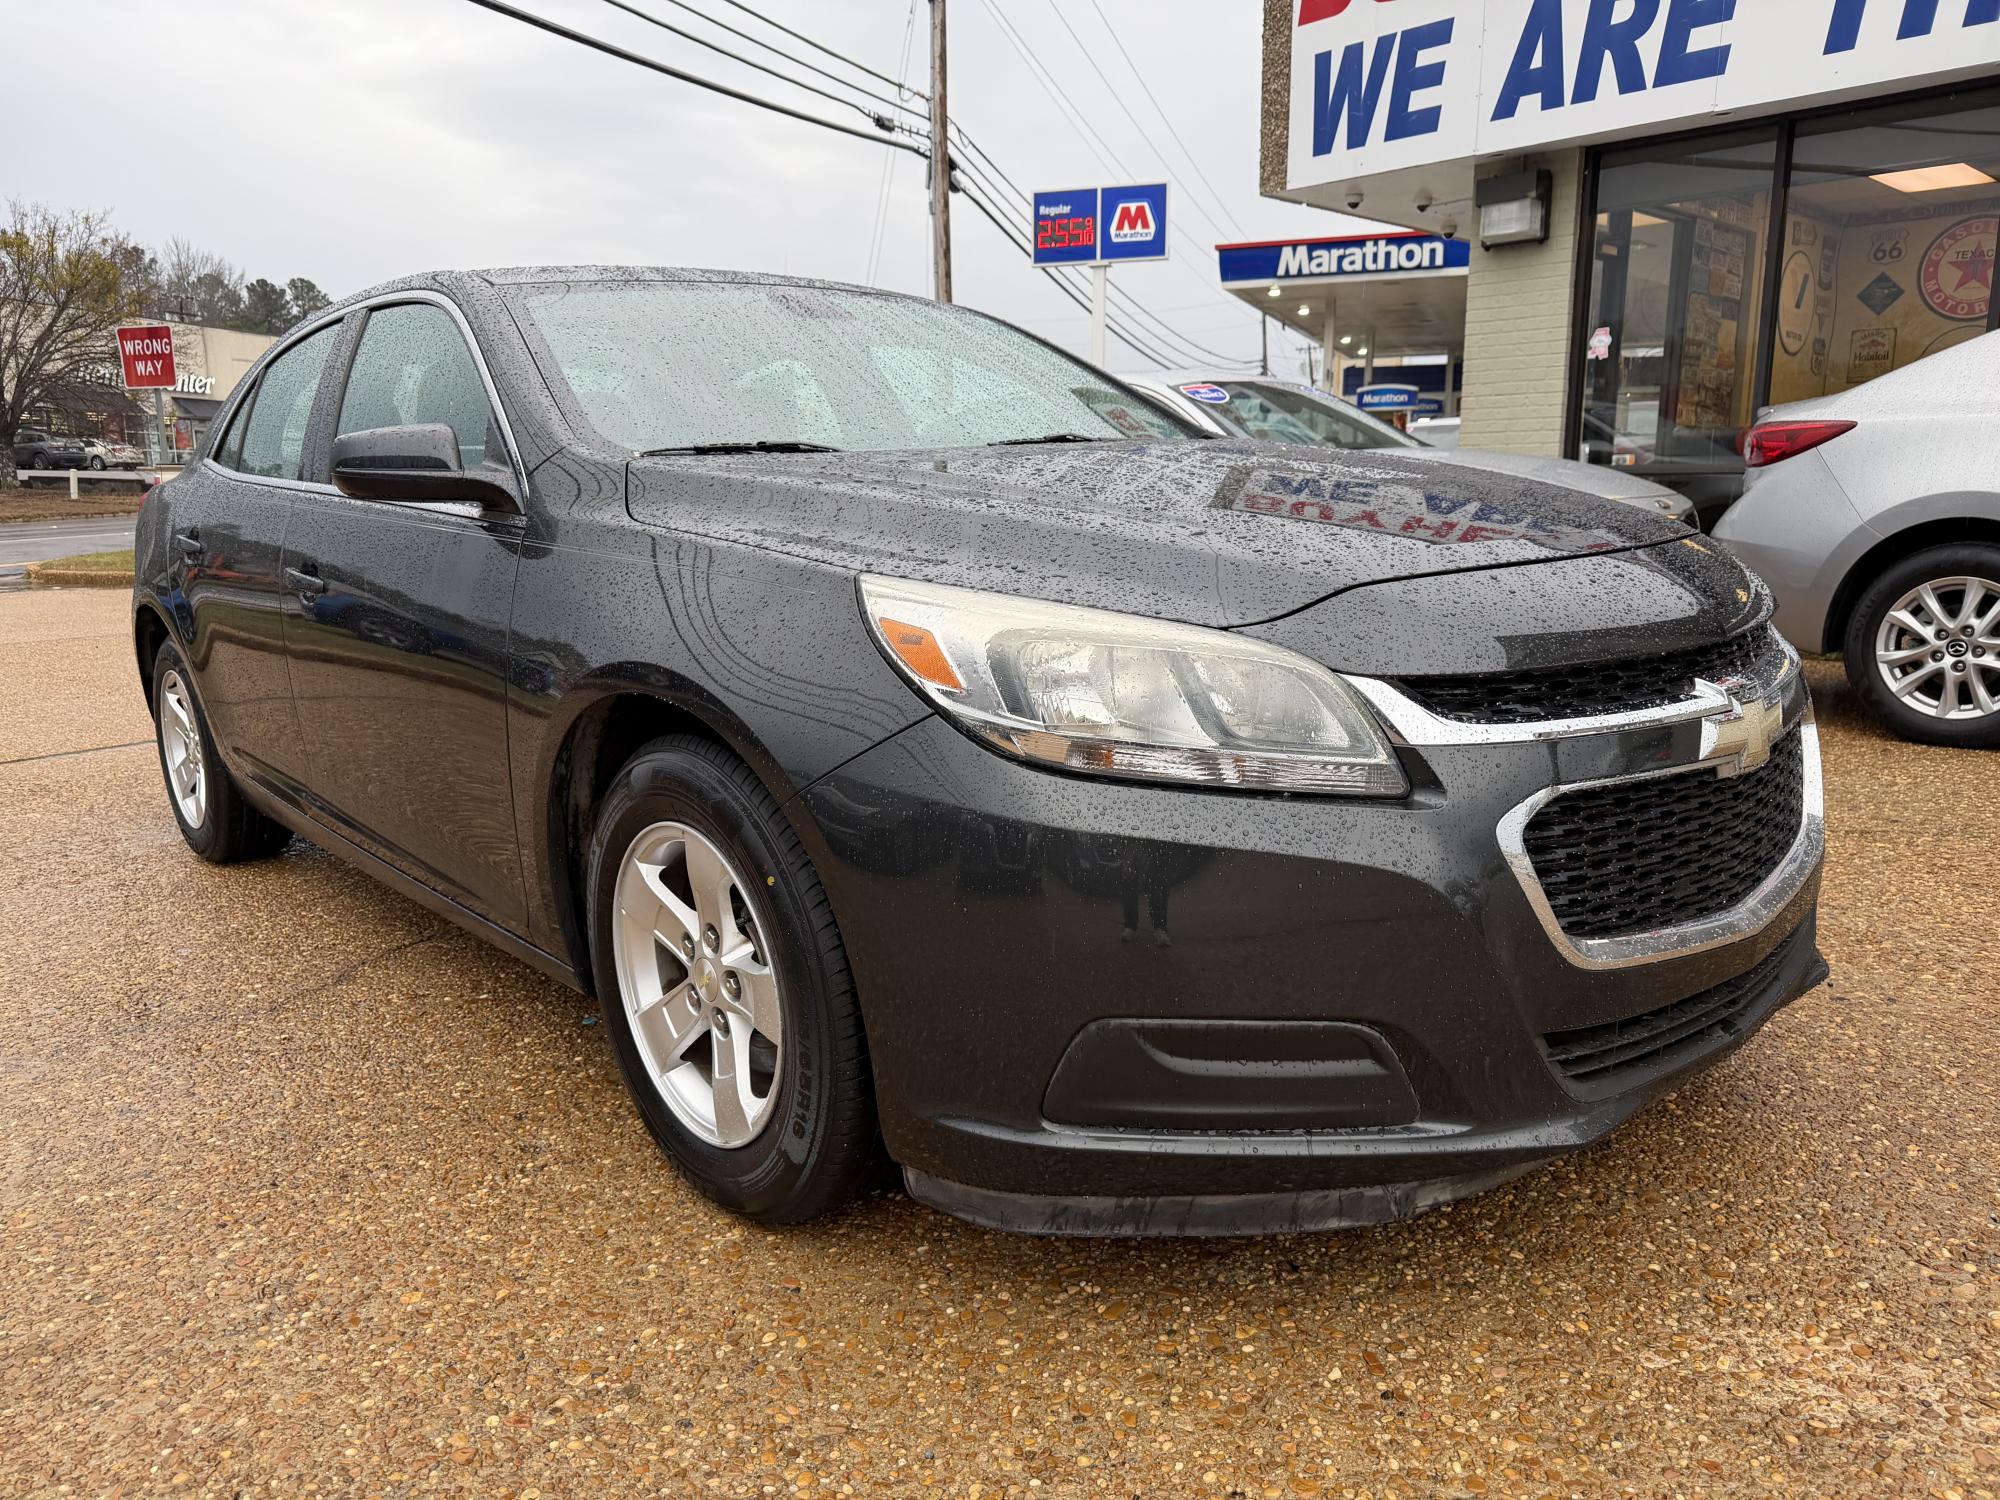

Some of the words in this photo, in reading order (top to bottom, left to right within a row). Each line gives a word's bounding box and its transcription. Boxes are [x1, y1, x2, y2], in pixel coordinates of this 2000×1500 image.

[1312, 16, 1455, 157] WE
[1490, 0, 1733, 122] ARE
[1039, 204, 1072, 216] Regular
[1115, 204, 1151, 231] M
[1114, 230, 1152, 240] Marathon
[1276, 239, 1444, 277] Marathon
[1873, 241, 1903, 261] 66
[1954, 248, 1995, 260] TEXAC
[123, 338, 171, 356] WRONG
[135, 359, 163, 376] WAY
[1362, 393, 1408, 404] Marathon
